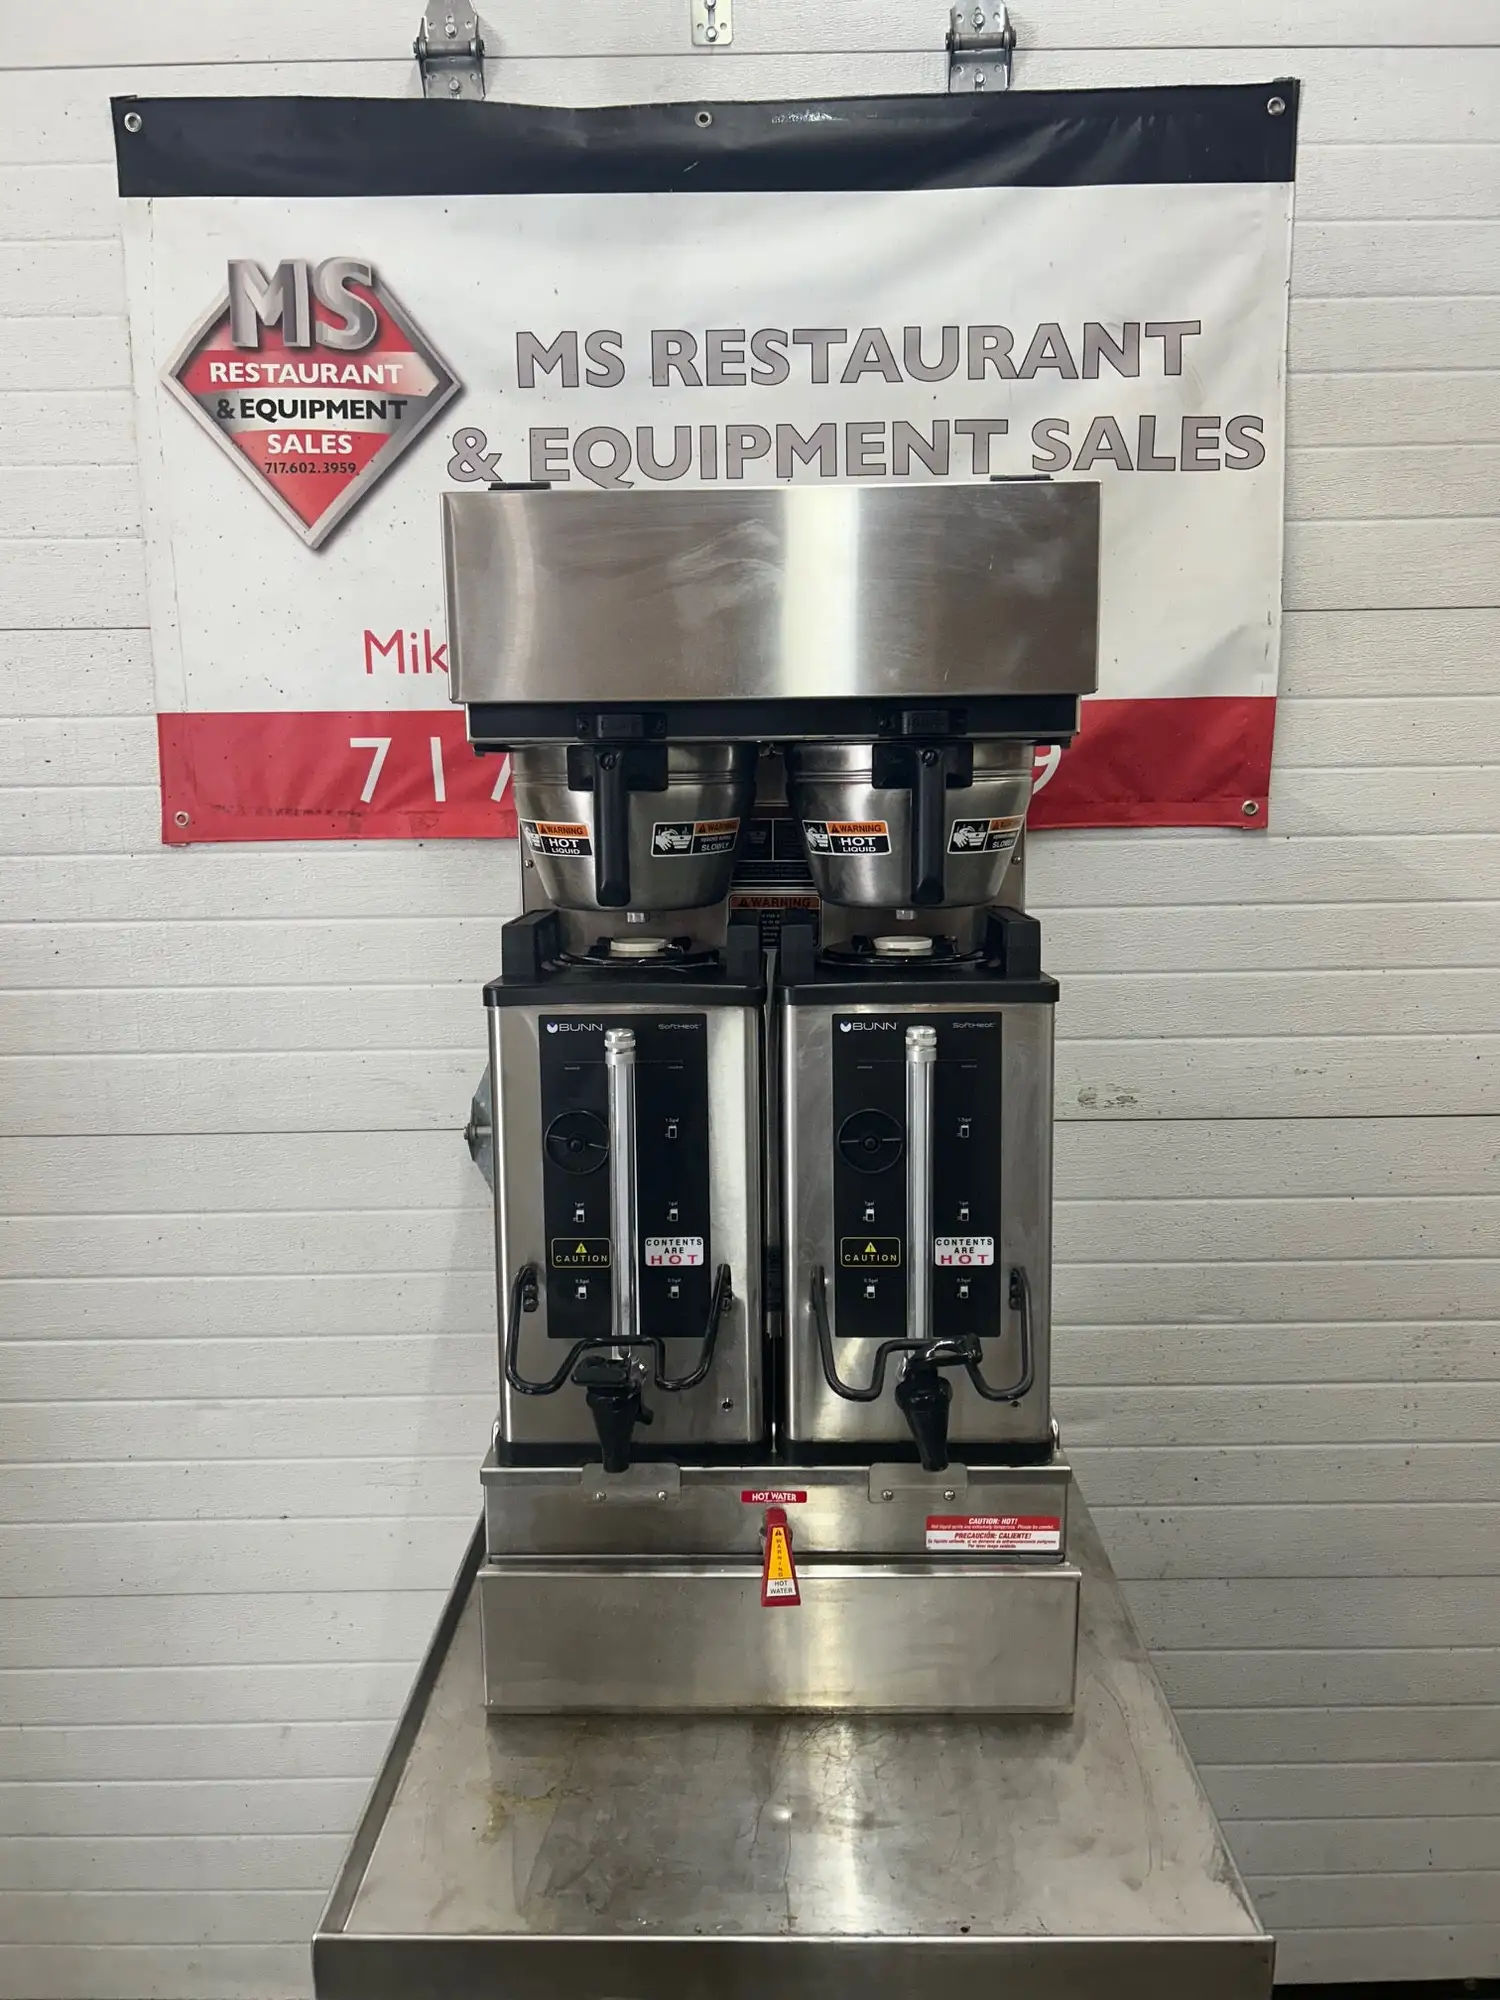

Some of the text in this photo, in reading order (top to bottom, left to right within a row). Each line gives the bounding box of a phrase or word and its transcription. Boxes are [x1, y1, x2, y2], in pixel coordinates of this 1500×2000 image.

[227, 257, 378, 350] MS
[516, 320, 1201, 388] MS RESTAURANT
[209, 362, 403, 385] RESTAURANT
[216, 399, 408, 423] & EQUIPMENT
[267, 434, 353, 455] SALES
[447, 415, 1265, 489] & EQUIPMENT SALES
[265, 462, 357, 475] 717.602.3959
[546, 825, 583, 835] WARNING
[839, 824, 881, 833] WARNING
[550, 838, 578, 848] HOT
[701, 841, 730, 852] SLOWLY
[841, 837, 876, 847] HOT
[753, 897, 810, 907] WARNING
[559, 1023, 603, 1032] BUNN
[853, 1022, 897, 1031] BUNN
[646, 1238, 702, 1246] CONTENTS
[936, 1238, 992, 1246] CONTENTS
[651, 1255, 698, 1265] HOT
[940, 1255, 988, 1264] HOT
[752, 1493, 769, 1501] HOT
[771, 1492, 797, 1502] WATER
[1001, 1517, 1018, 1525] HOT!
[776, 1539, 784, 1577] WARNING
